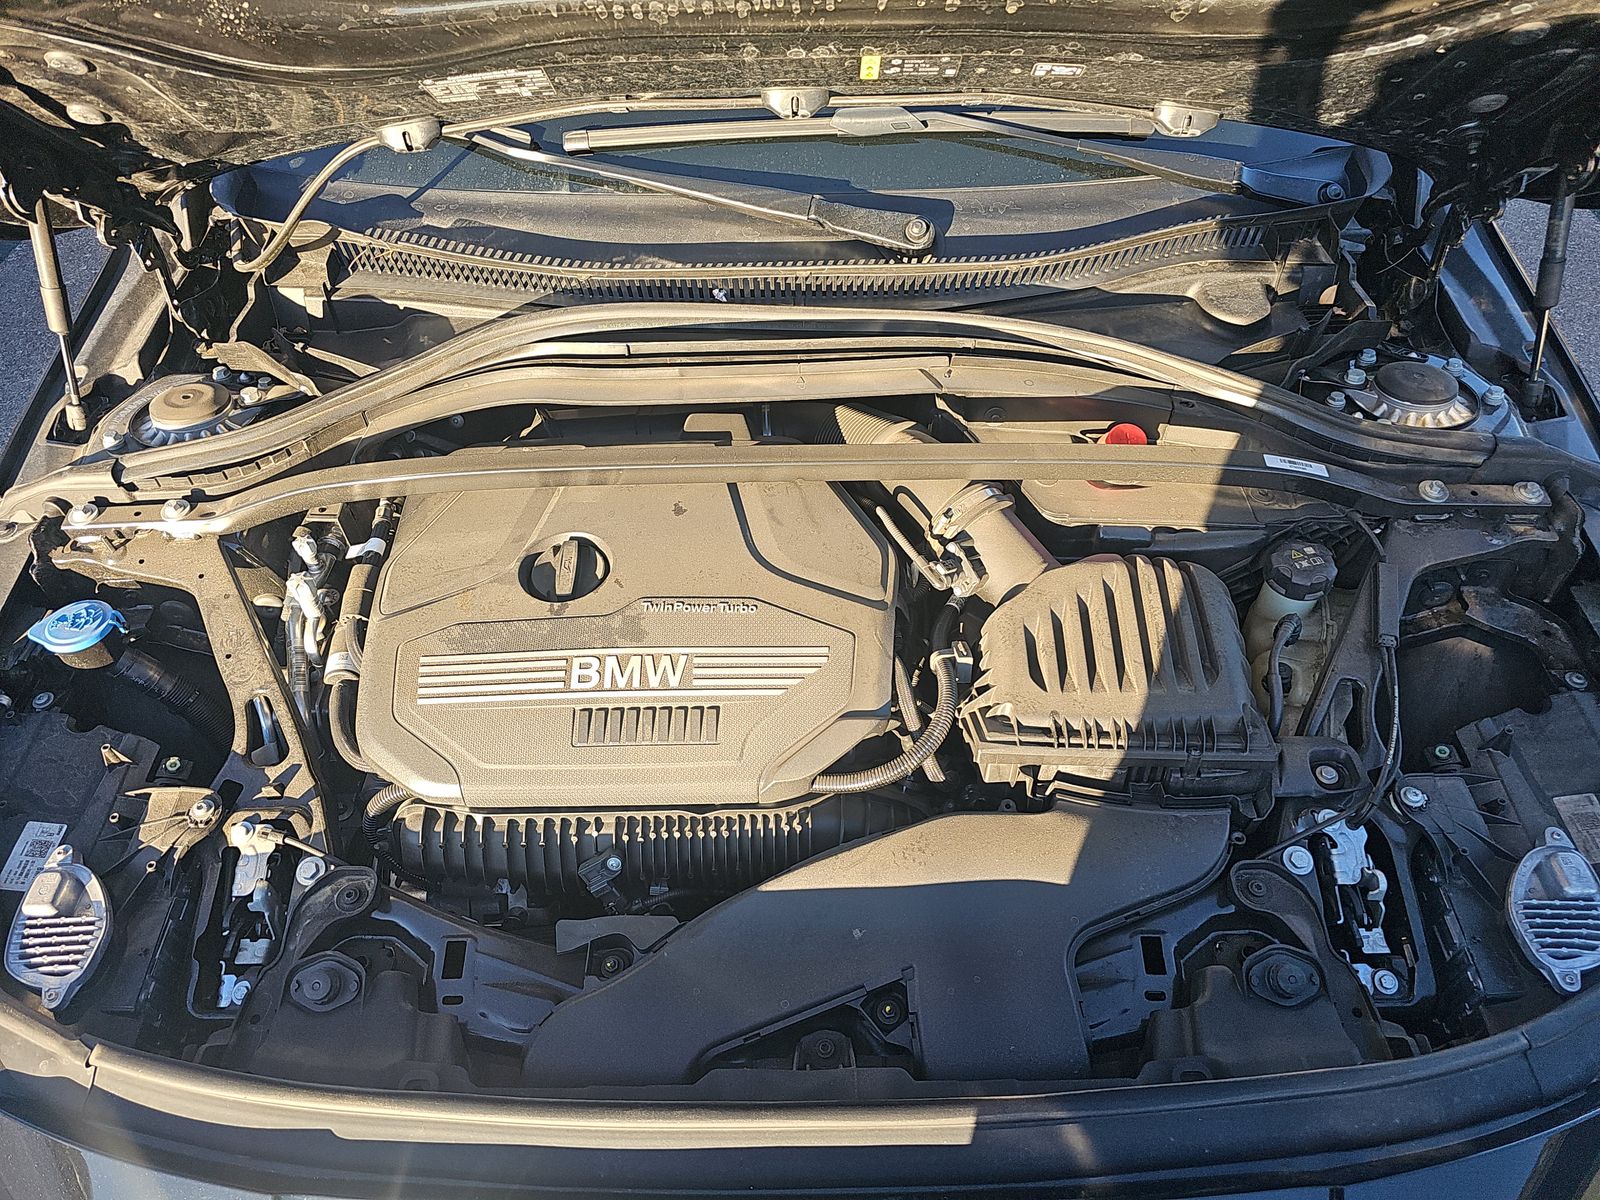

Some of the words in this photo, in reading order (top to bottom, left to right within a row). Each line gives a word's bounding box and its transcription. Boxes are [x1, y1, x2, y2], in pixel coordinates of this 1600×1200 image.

[643, 601, 718, 613] TwinPower
[719, 602, 758, 613] Turbo
[570, 654, 688, 689] BMW
